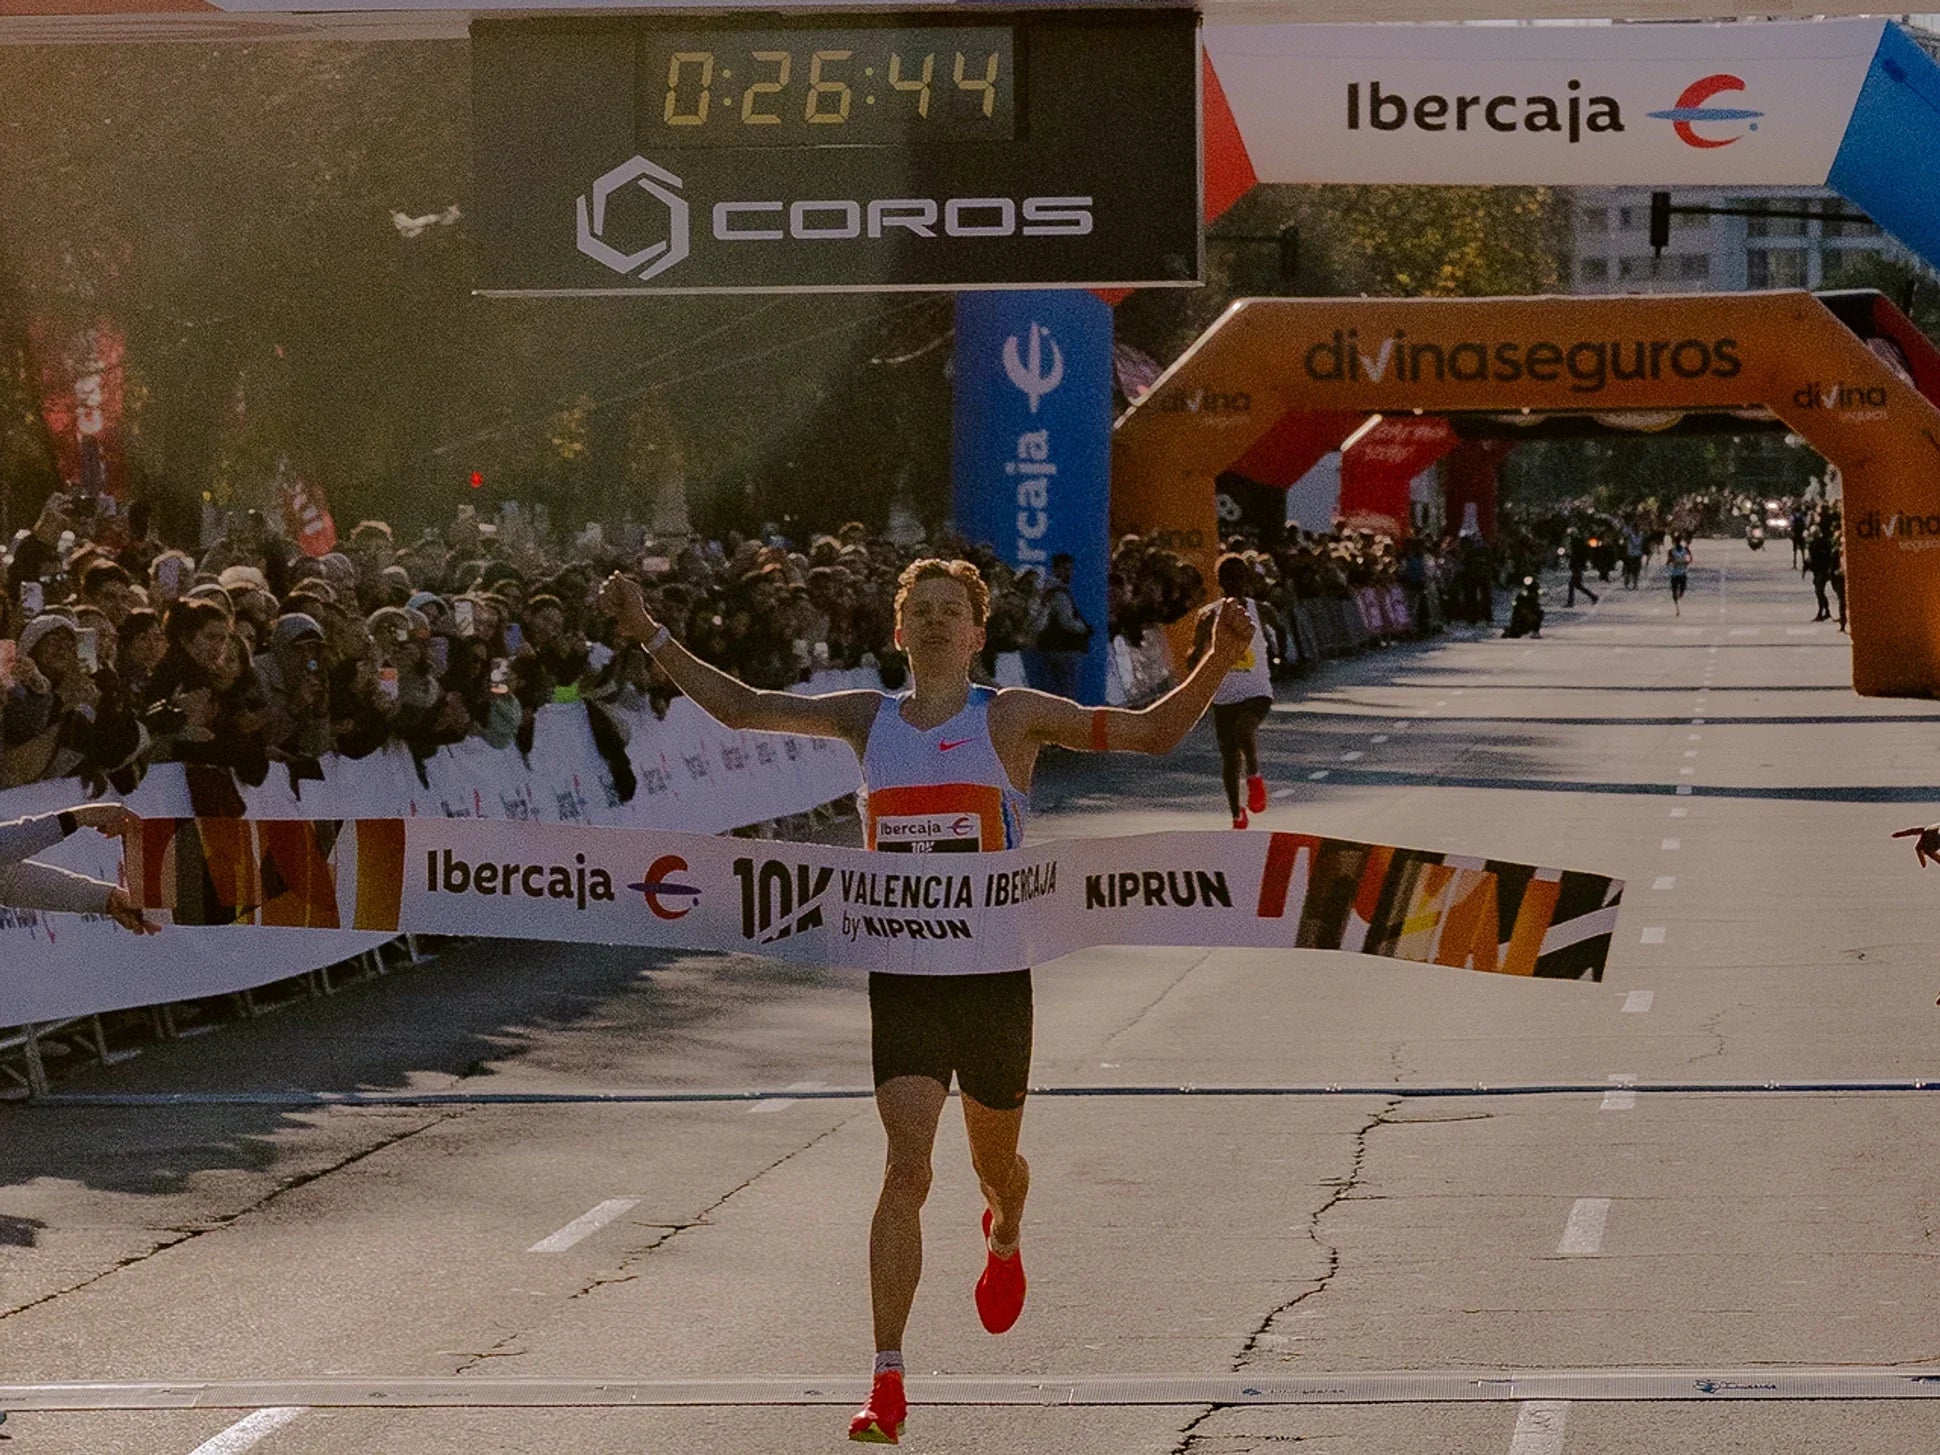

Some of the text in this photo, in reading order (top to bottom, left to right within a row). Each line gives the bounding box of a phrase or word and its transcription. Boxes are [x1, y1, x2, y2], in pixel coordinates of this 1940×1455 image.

[663, 51, 1000, 126] 0:26:44
[1346, 79, 1626, 143] Ibercaja
[712, 196, 1094, 241] COROS
[1305, 329, 1742, 392] divinaseguros
[1793, 381, 1887, 410] divina
[1004, 428, 1058, 590] rcaja
[1856, 510, 1940, 539] divina
[880, 820, 943, 836] Ibercaja
[427, 849, 615, 910] Ibercaja
[733, 857, 1058, 945] 10K VALENCIA IBERCAJA
[1085, 870, 1234, 909] KIPRUN
[842, 911, 973, 940] by KIPRUN
